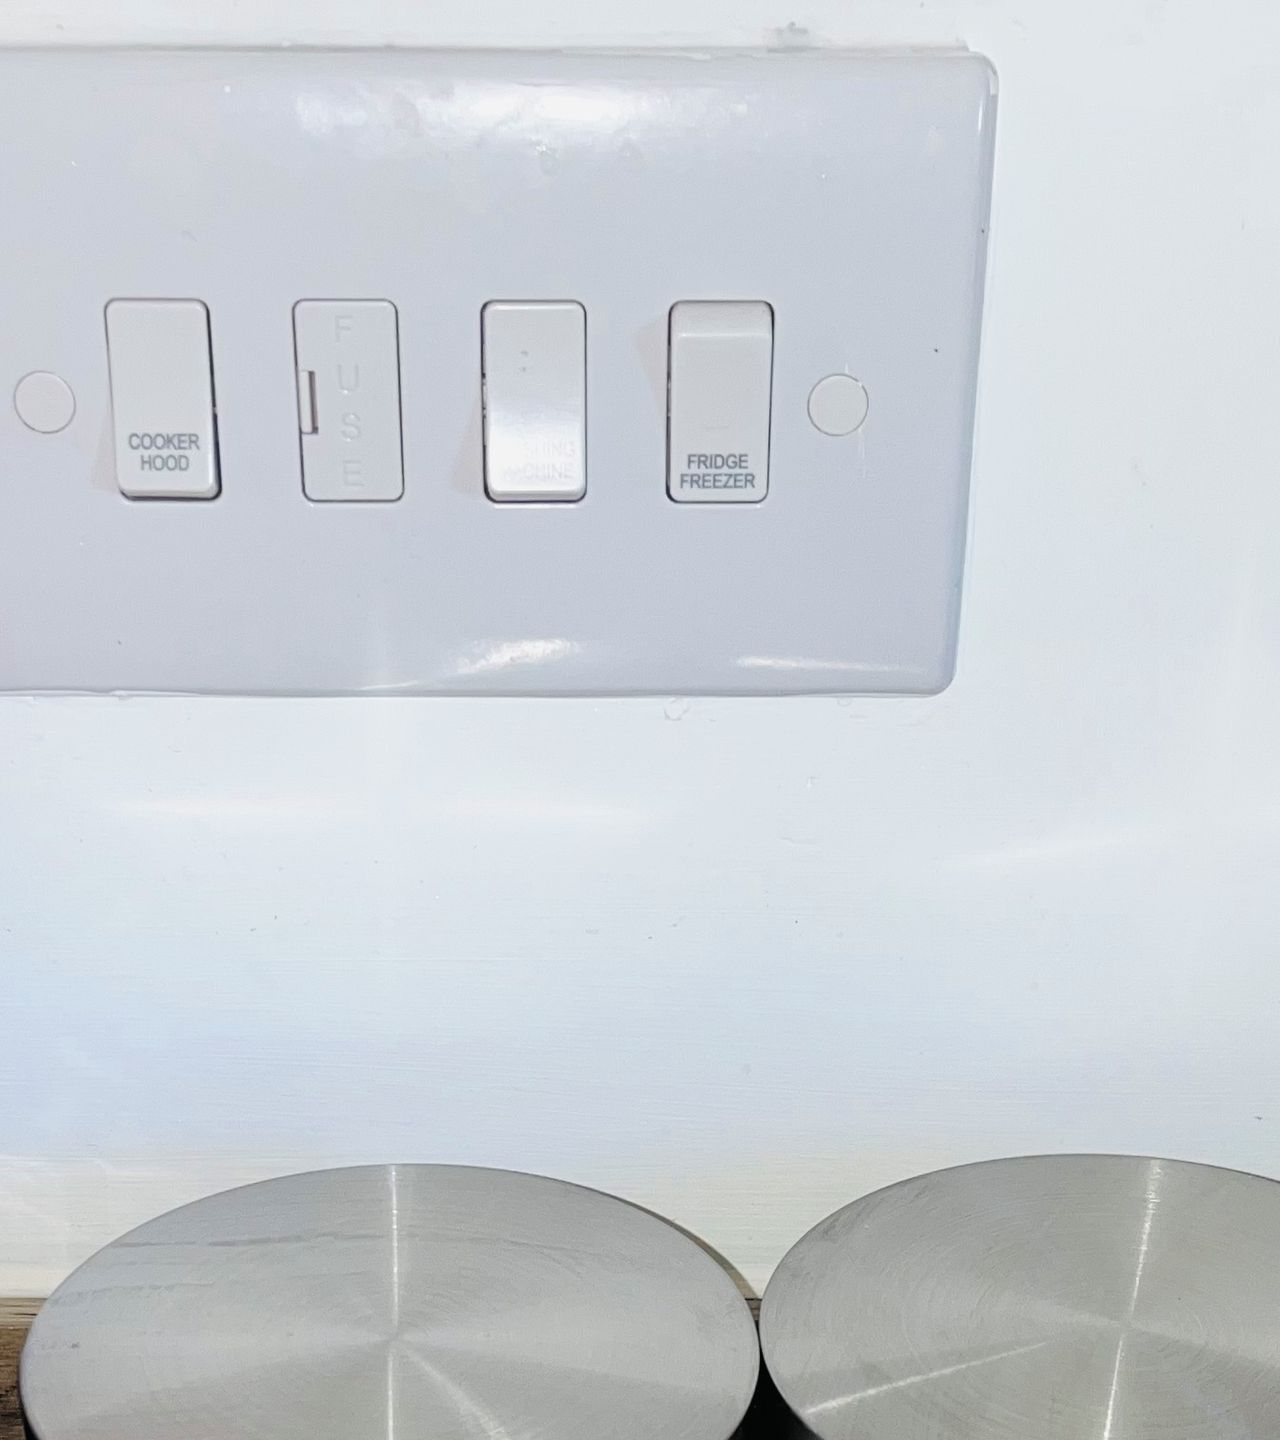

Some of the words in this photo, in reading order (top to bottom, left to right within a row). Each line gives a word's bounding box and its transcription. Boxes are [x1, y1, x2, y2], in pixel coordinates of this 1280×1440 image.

[333, 314, 365, 488] FUSE
[128, 433, 201, 451] COOKER
[140, 454, 190, 472] HOOD
[687, 453, 749, 470] FRIDGE
[680, 473, 756, 489] FREEZER
